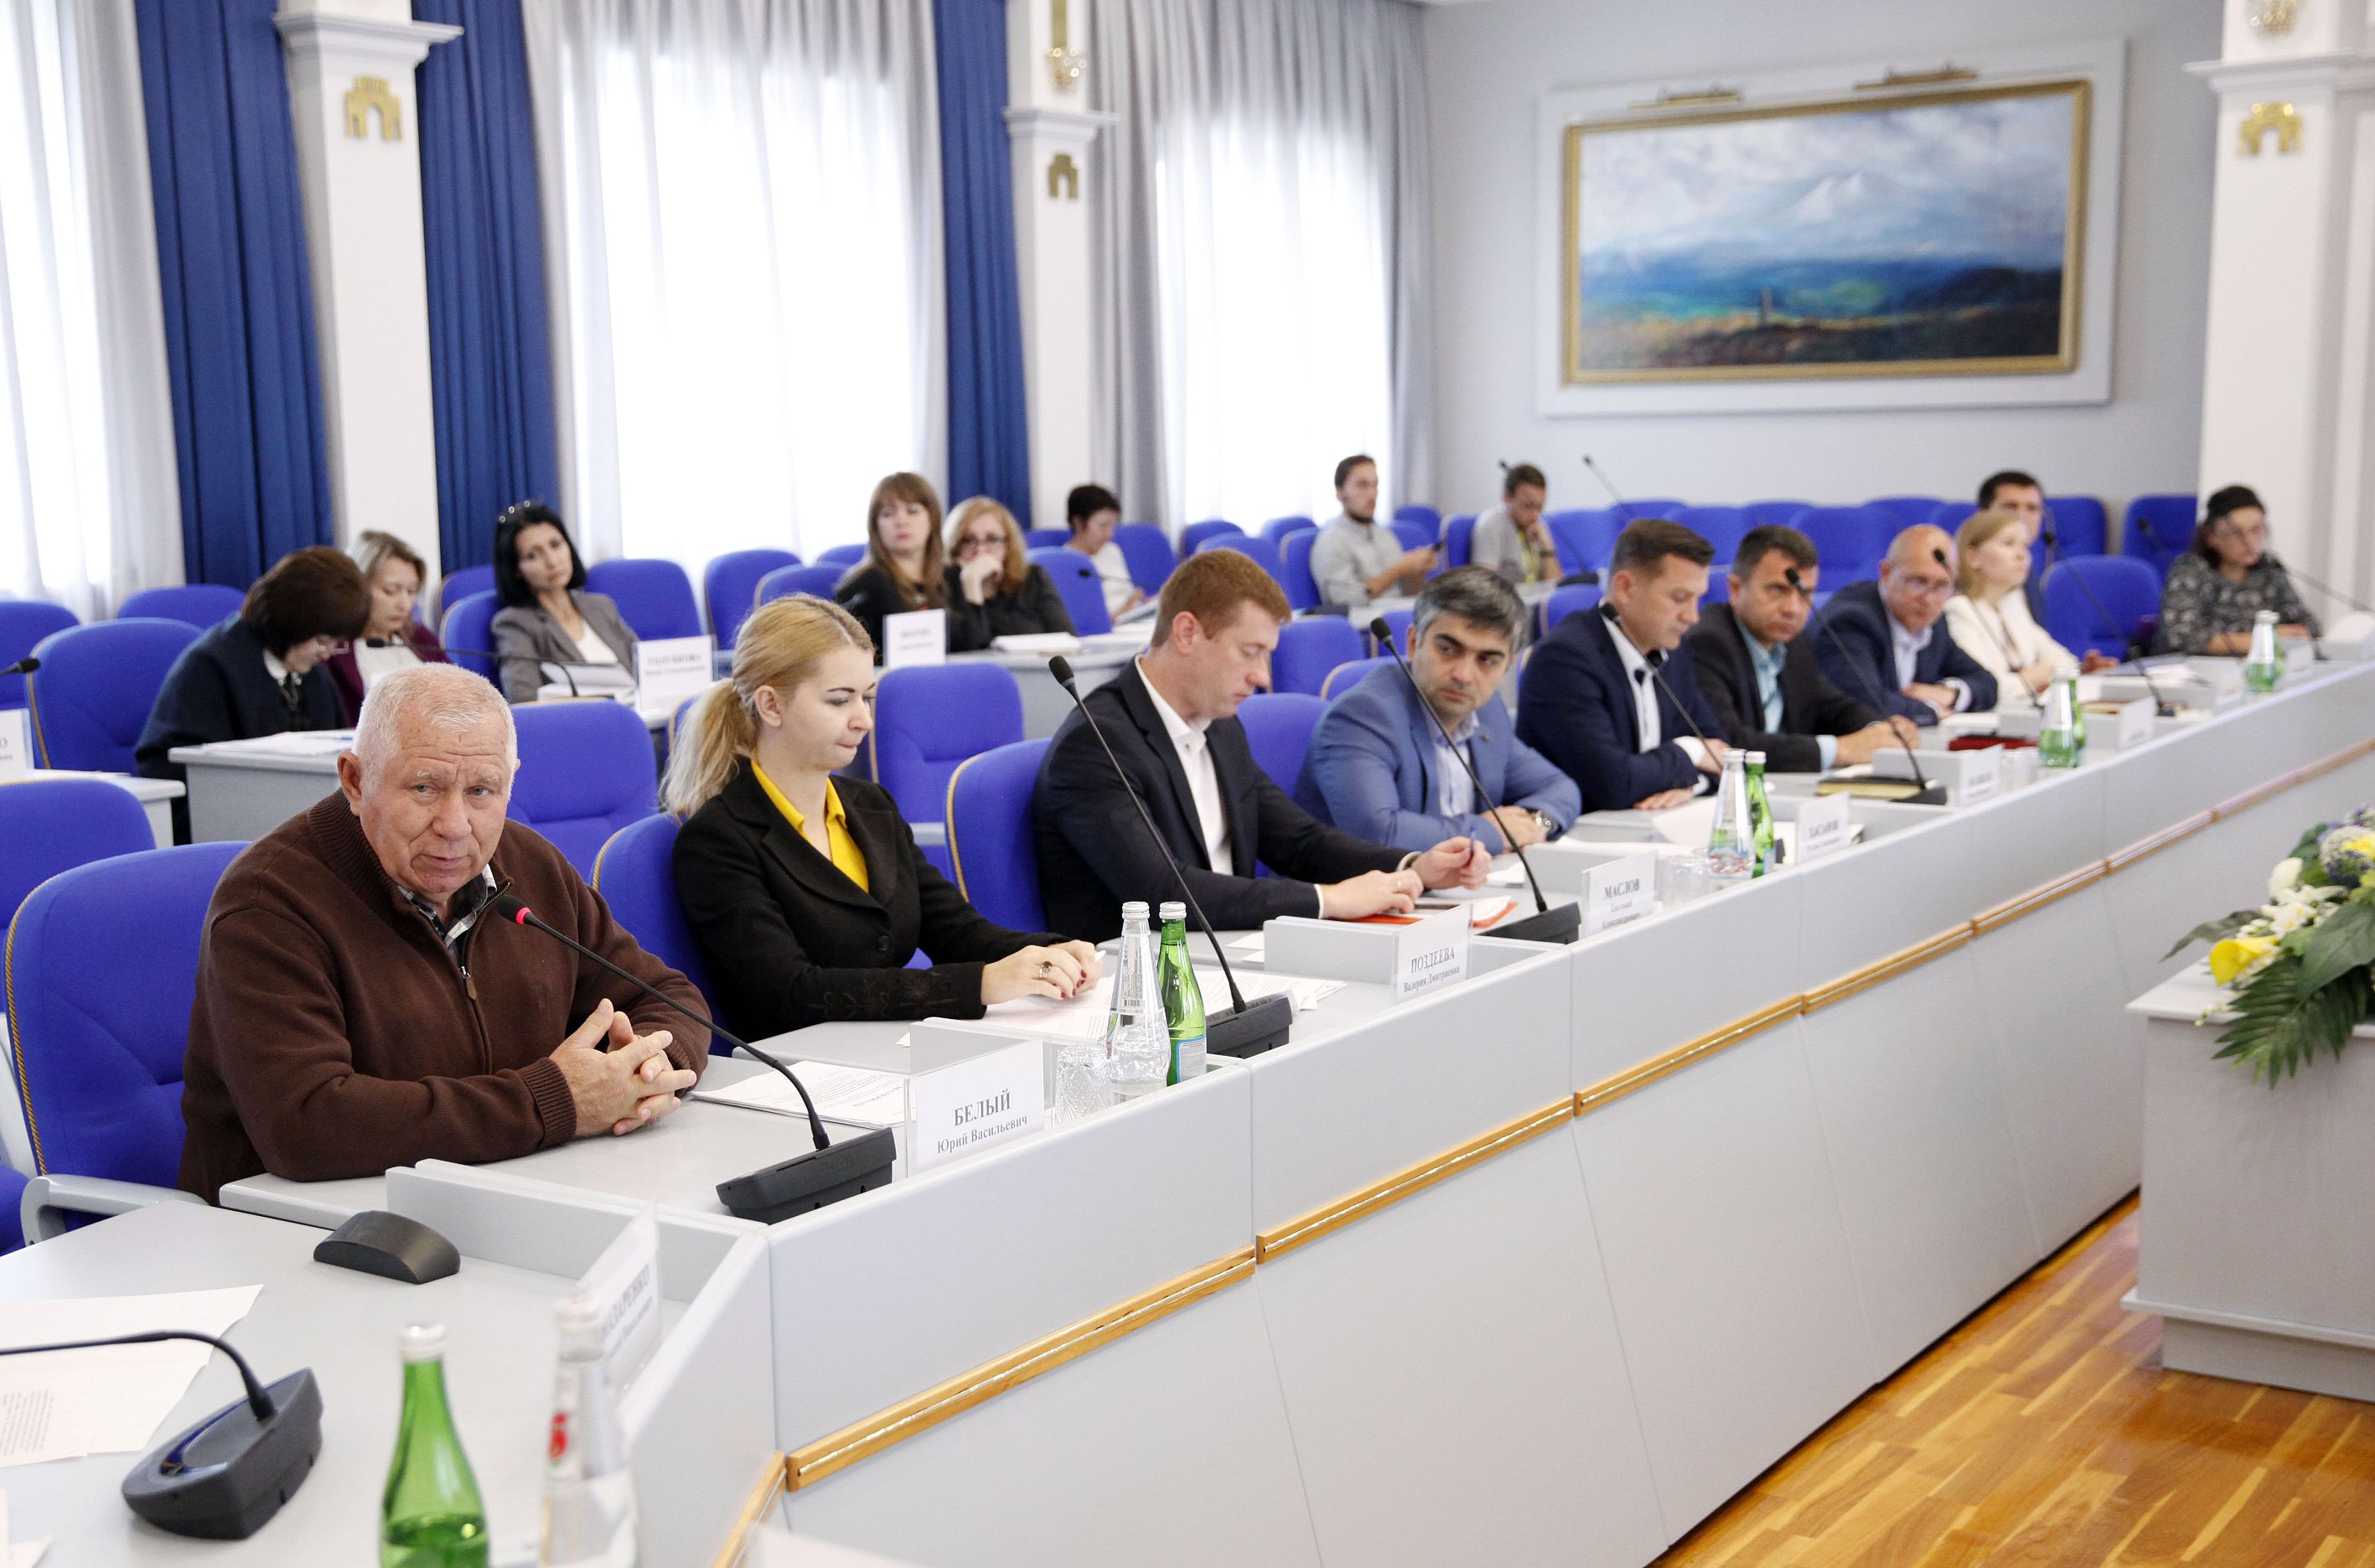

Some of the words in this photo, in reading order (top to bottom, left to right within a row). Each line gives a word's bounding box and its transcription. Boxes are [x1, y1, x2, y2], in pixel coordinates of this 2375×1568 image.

[1604, 877, 1640, 899] МАСЛОВ
[1410, 946, 1455, 973] ПОЗДЕЕВА
[954, 1089, 1011, 1126] БЕЛЫЙ
[937, 1131, 968, 1154] Юрий
[970, 1115, 1027, 1143] Васильевич
